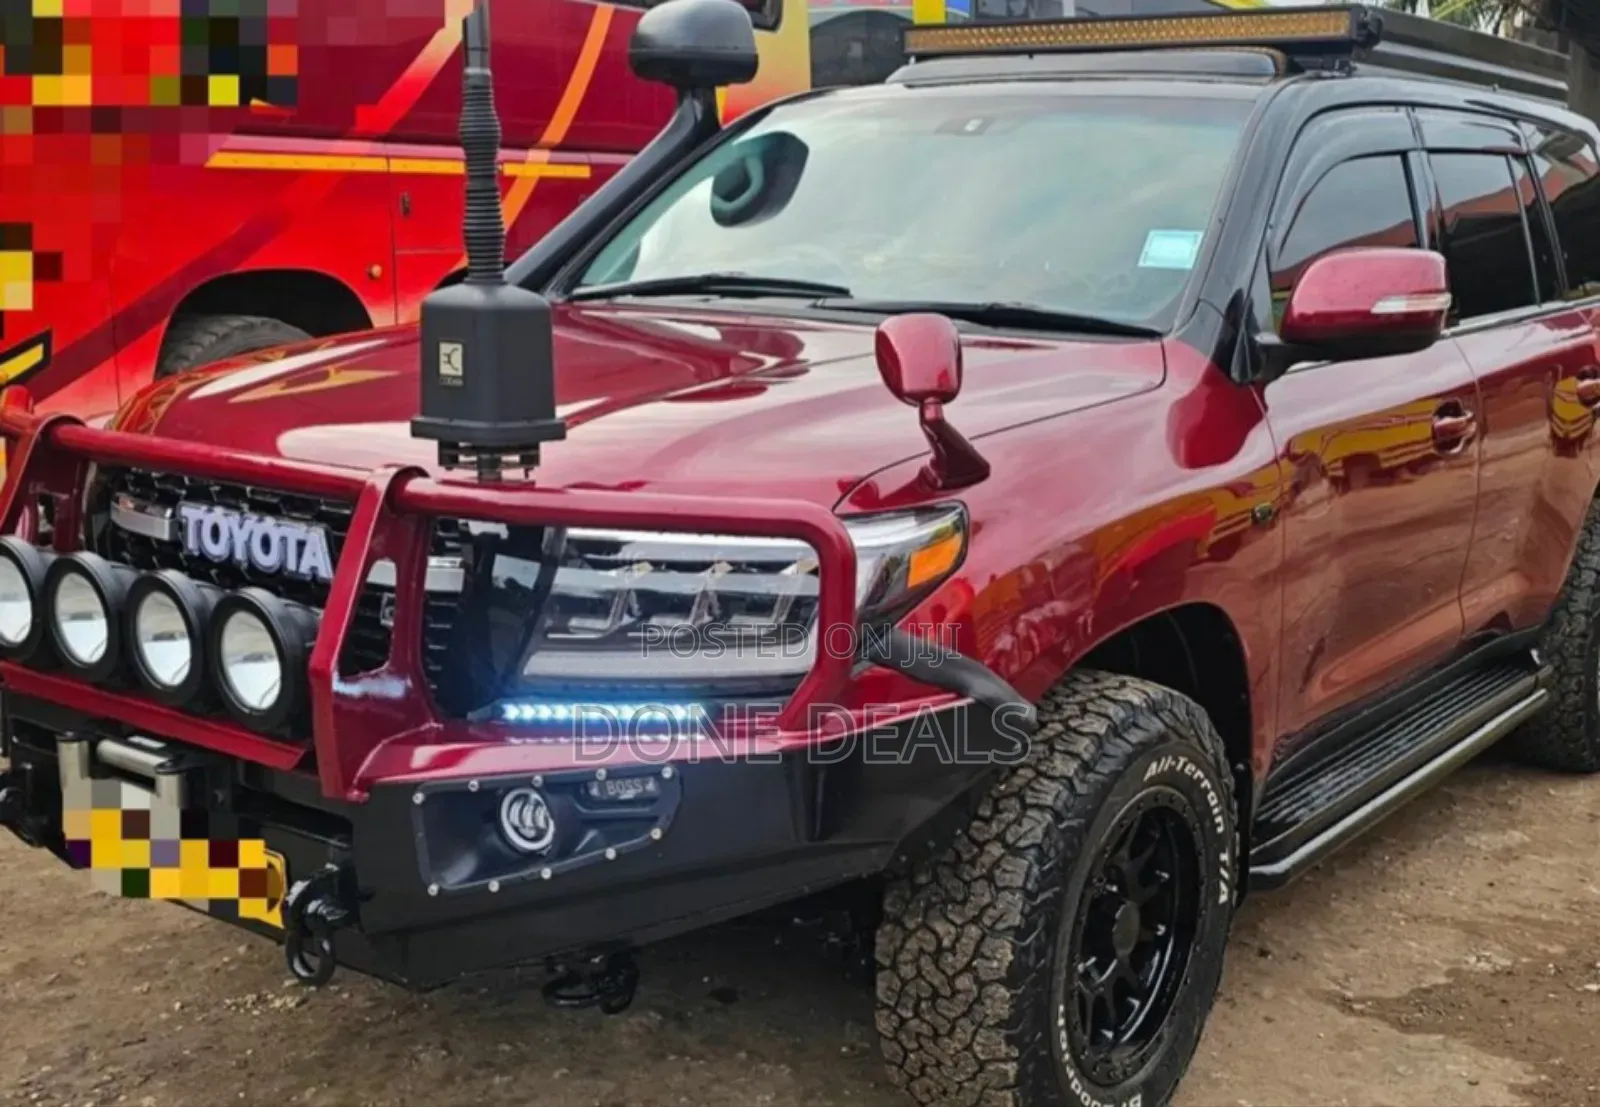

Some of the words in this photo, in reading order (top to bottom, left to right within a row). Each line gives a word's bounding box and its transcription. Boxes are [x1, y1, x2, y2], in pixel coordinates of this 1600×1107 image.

[178, 503, 334, 581] TOYOTA
[605, 778, 644, 796] BOSS
[1143, 754, 1226, 834] All-Terrain
[1218, 847, 1230, 905] T/A
